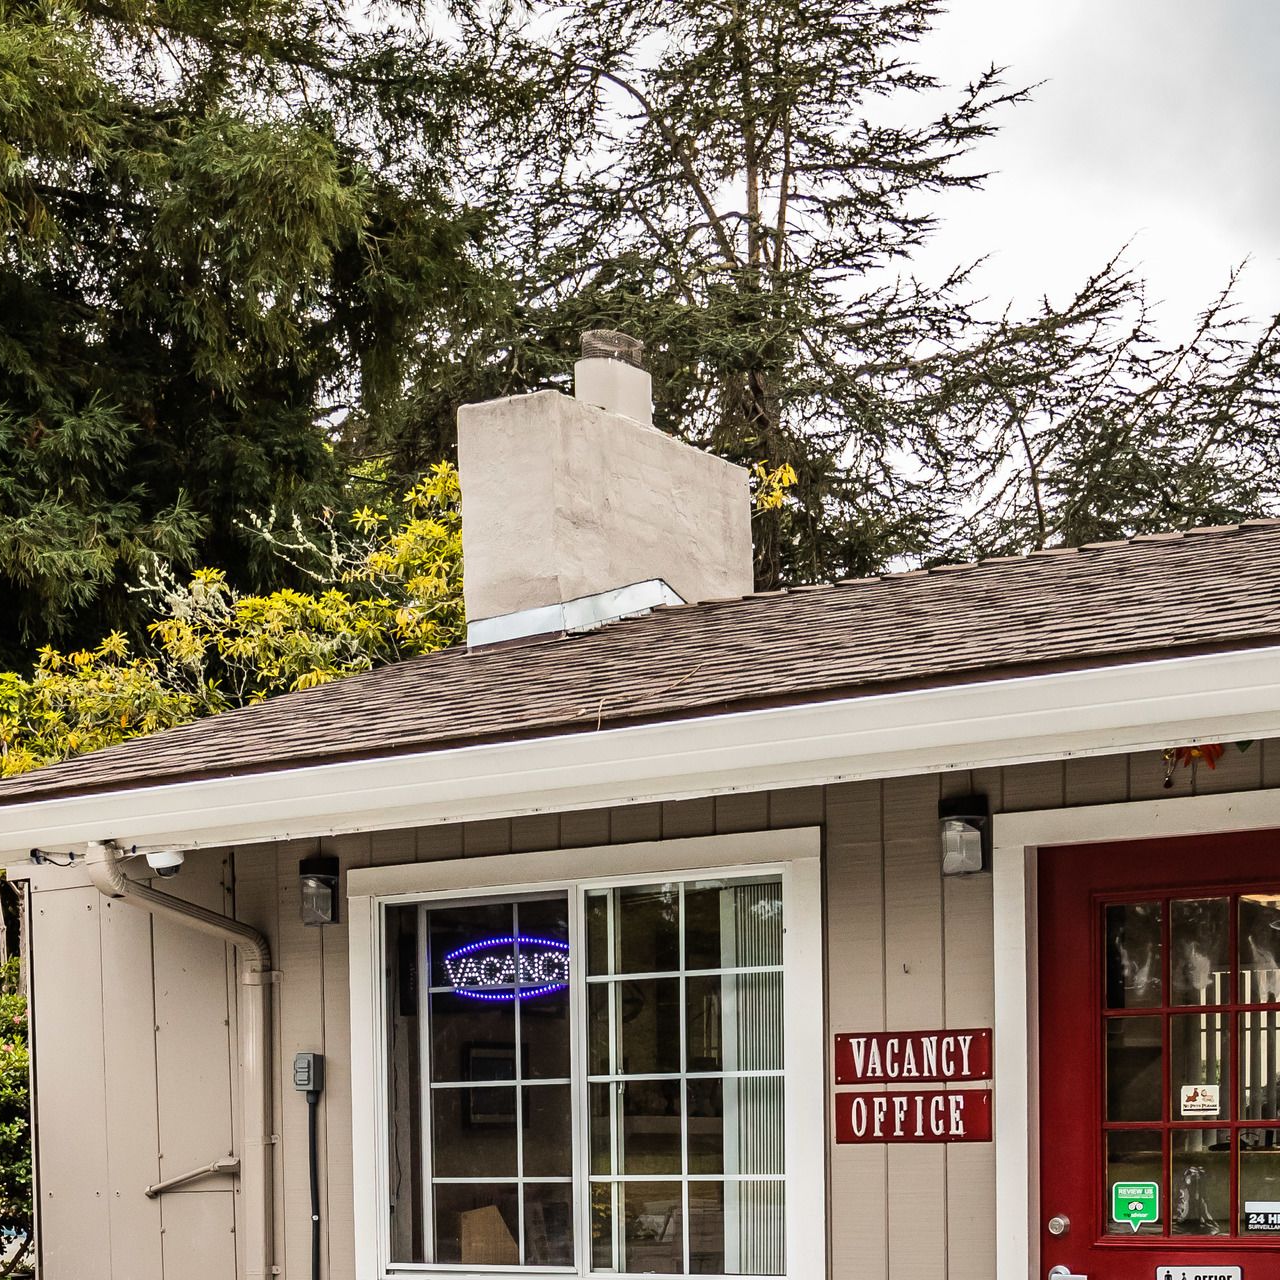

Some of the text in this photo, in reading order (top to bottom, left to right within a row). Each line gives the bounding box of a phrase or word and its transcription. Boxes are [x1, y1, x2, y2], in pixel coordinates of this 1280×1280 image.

[849, 1035, 973, 1078] VACANCY
[851, 1095, 964, 1137] OFFICE
[1249, 1213, 1265, 1224] 24
